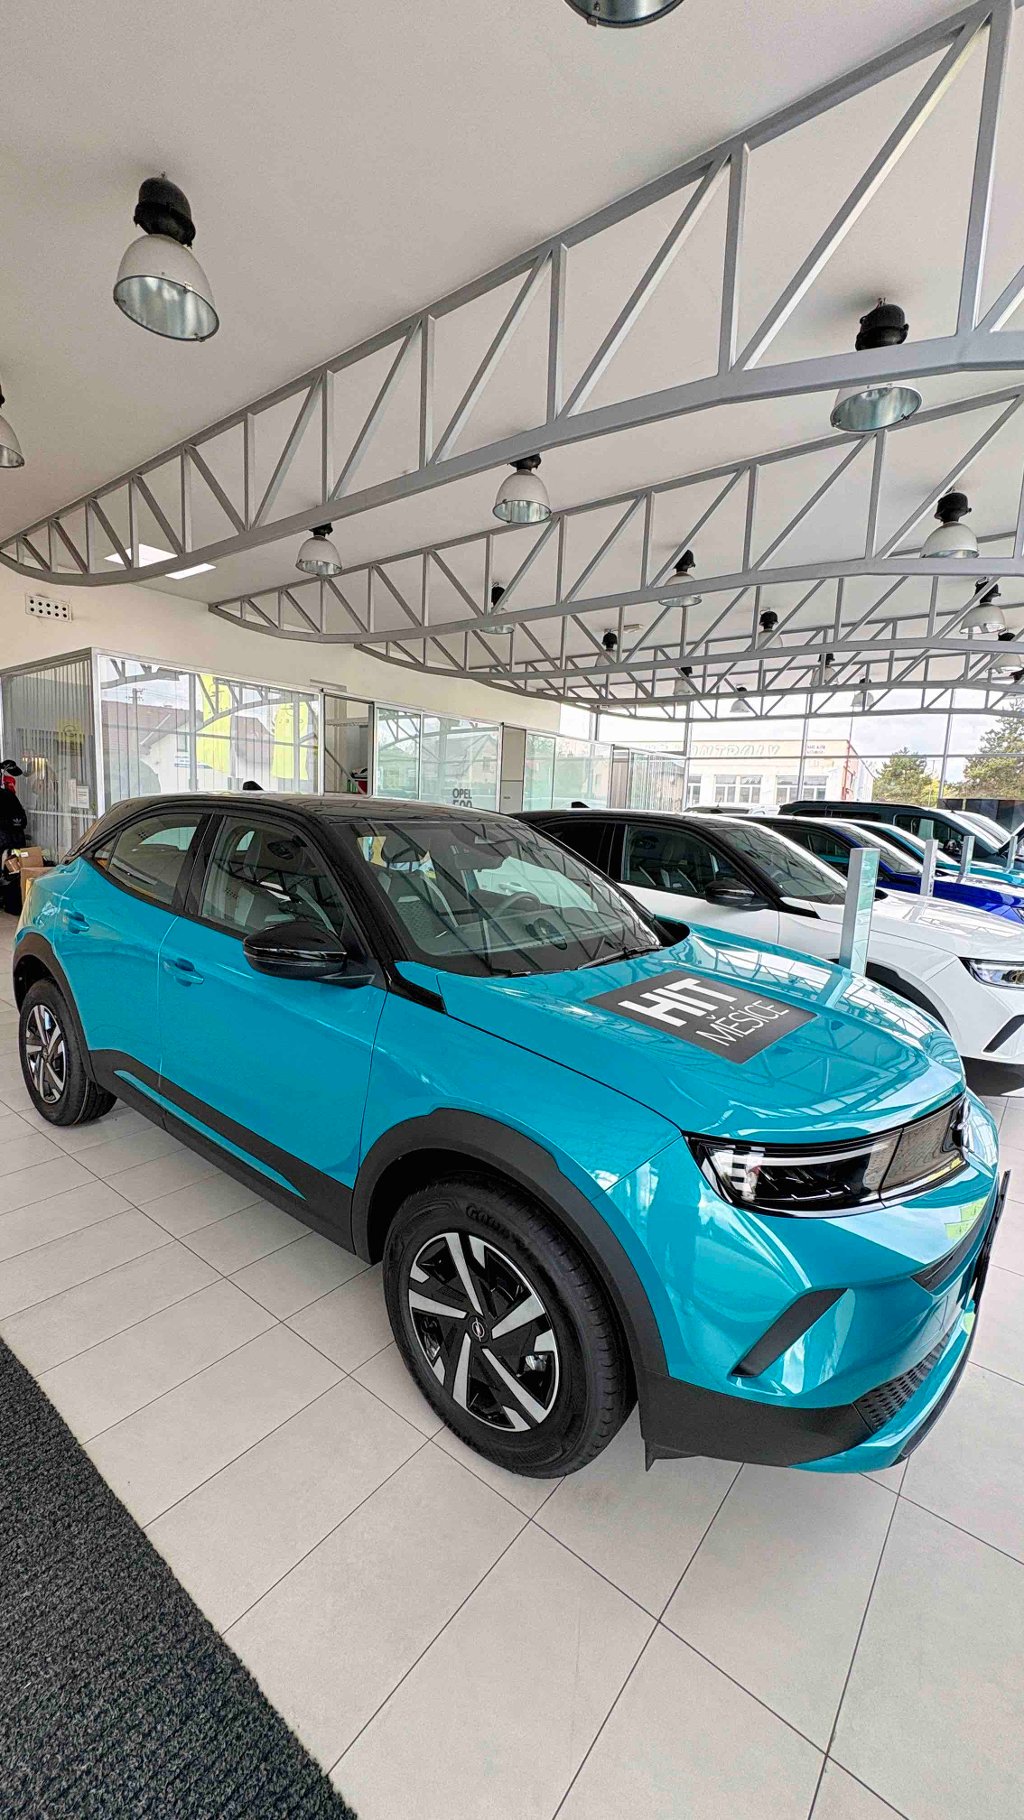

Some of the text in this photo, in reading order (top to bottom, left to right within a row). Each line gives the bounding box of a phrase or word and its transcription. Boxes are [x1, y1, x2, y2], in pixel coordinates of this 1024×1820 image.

[453, 788, 472, 799] OPEL
[618, 977, 738, 1027] HIT
[696, 1000, 789, 1046] MĚSÍCE
